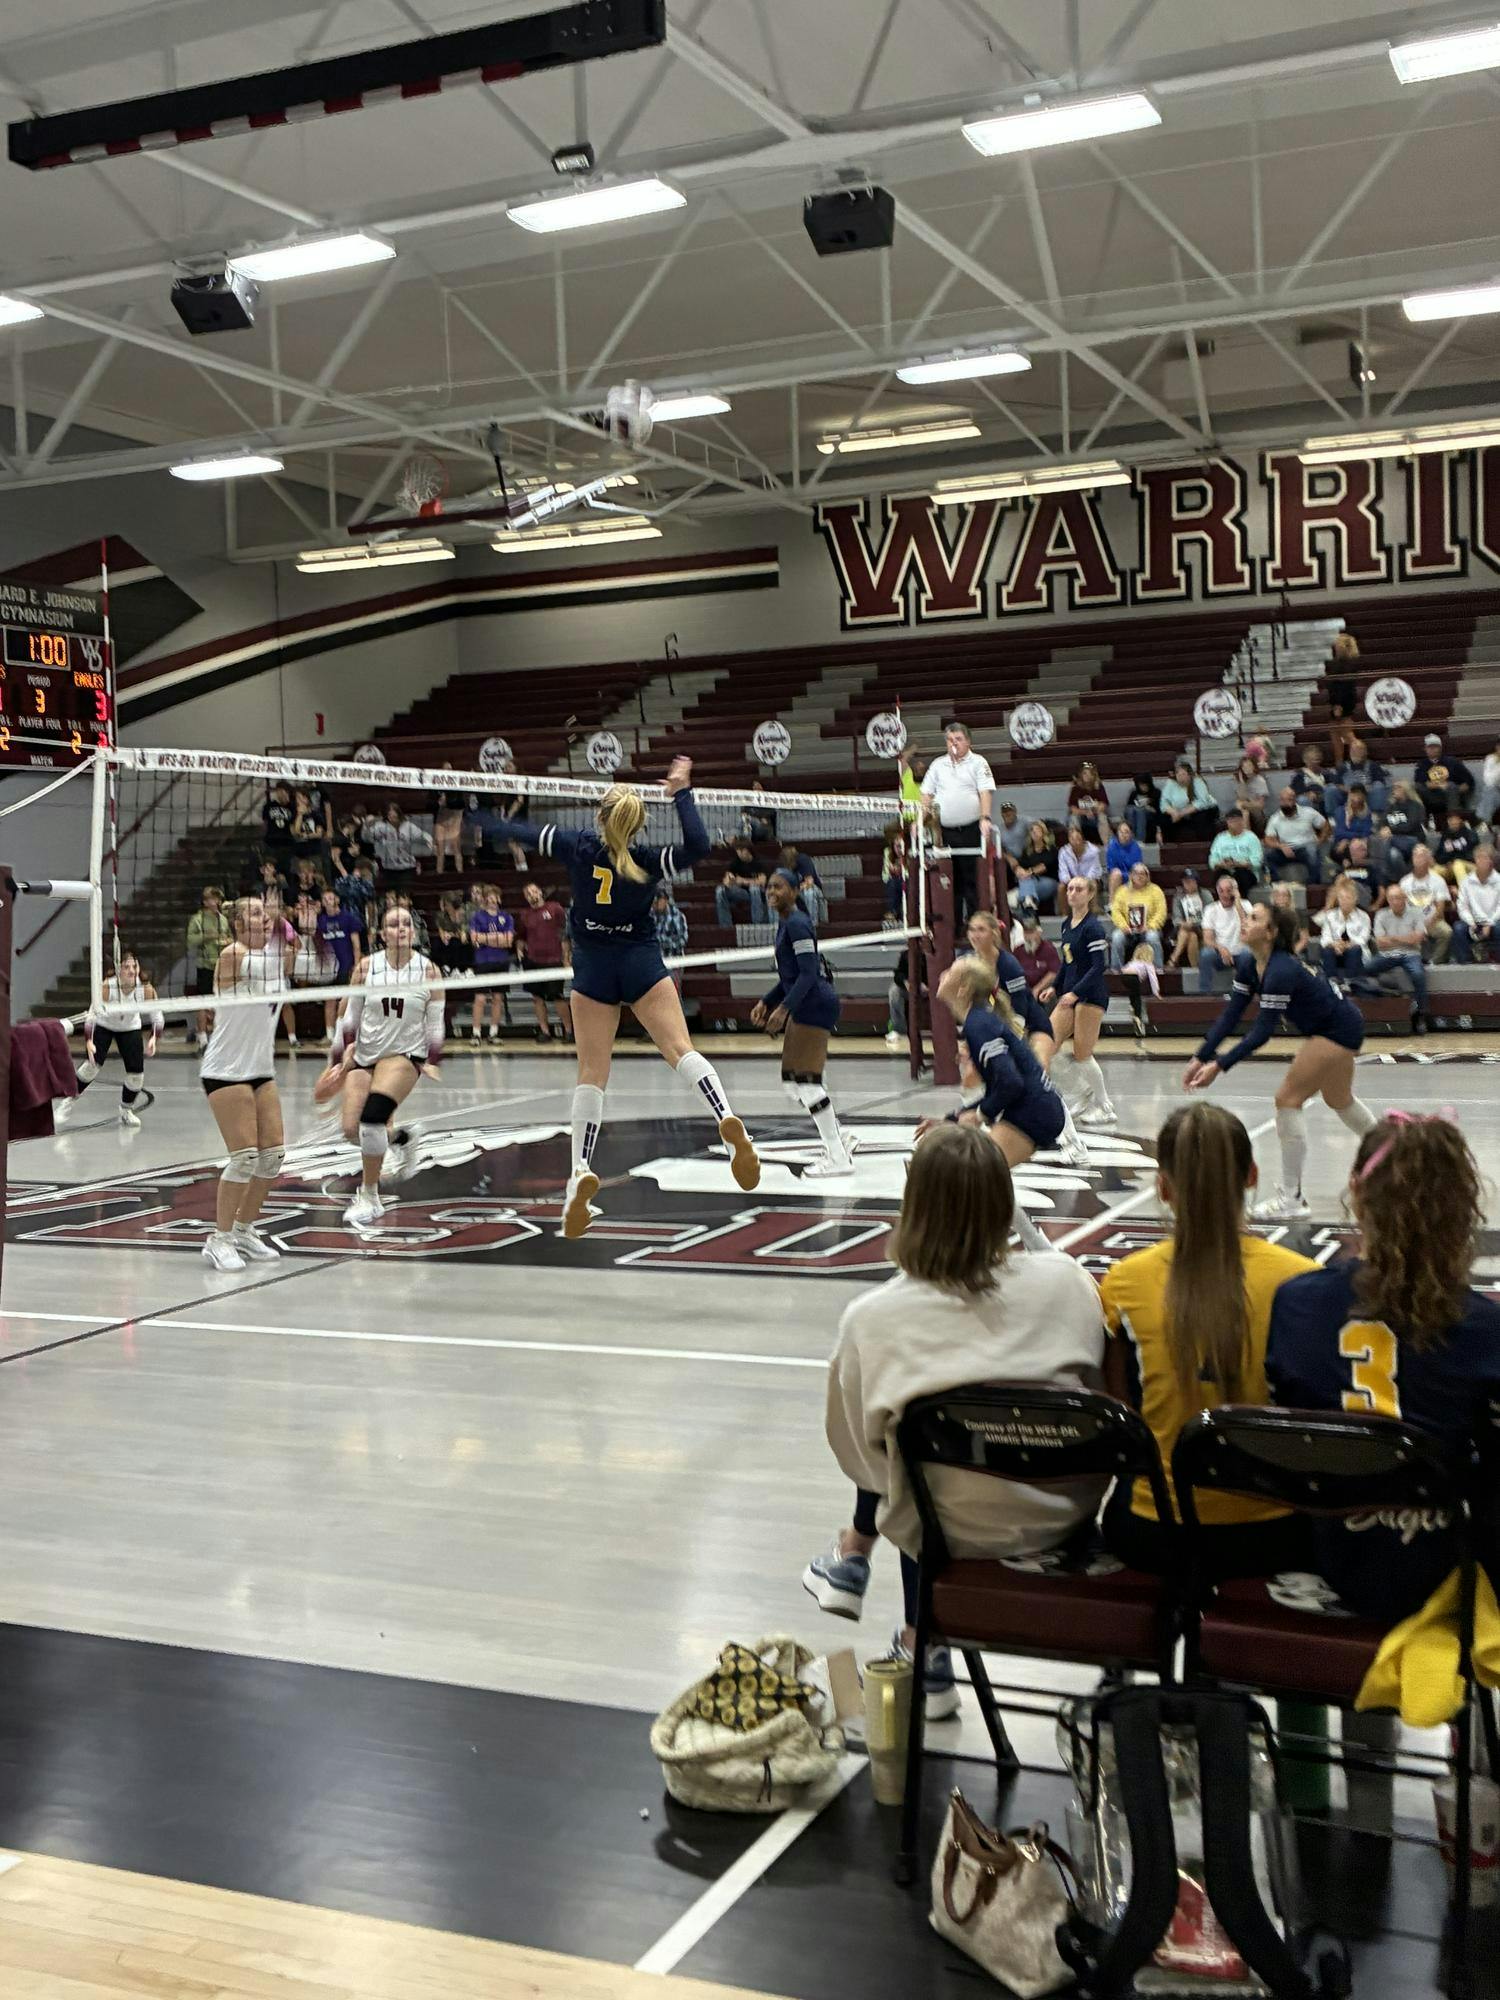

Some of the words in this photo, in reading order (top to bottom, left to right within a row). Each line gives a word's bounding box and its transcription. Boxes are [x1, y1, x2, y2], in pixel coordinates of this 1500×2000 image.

[0, 585, 26, 603] ARD
[44, 591, 96, 614] JOHNSON
[1, 603, 74, 629] GYMNASIUM
[29, 633, 66, 666] 1:00
[73, 671, 104, 689] EAGLES
[35, 688, 46, 713] 3
[95, 689, 107, 721] 3
[71, 730, 81, 755] 2
[592, 865, 613, 905] 7
[381, 997, 404, 1019] 14
[1339, 1319, 1402, 1420] 3
[964, 1419, 1005, 1434] Courtesy
[1016, 1423, 1034, 1435] the
